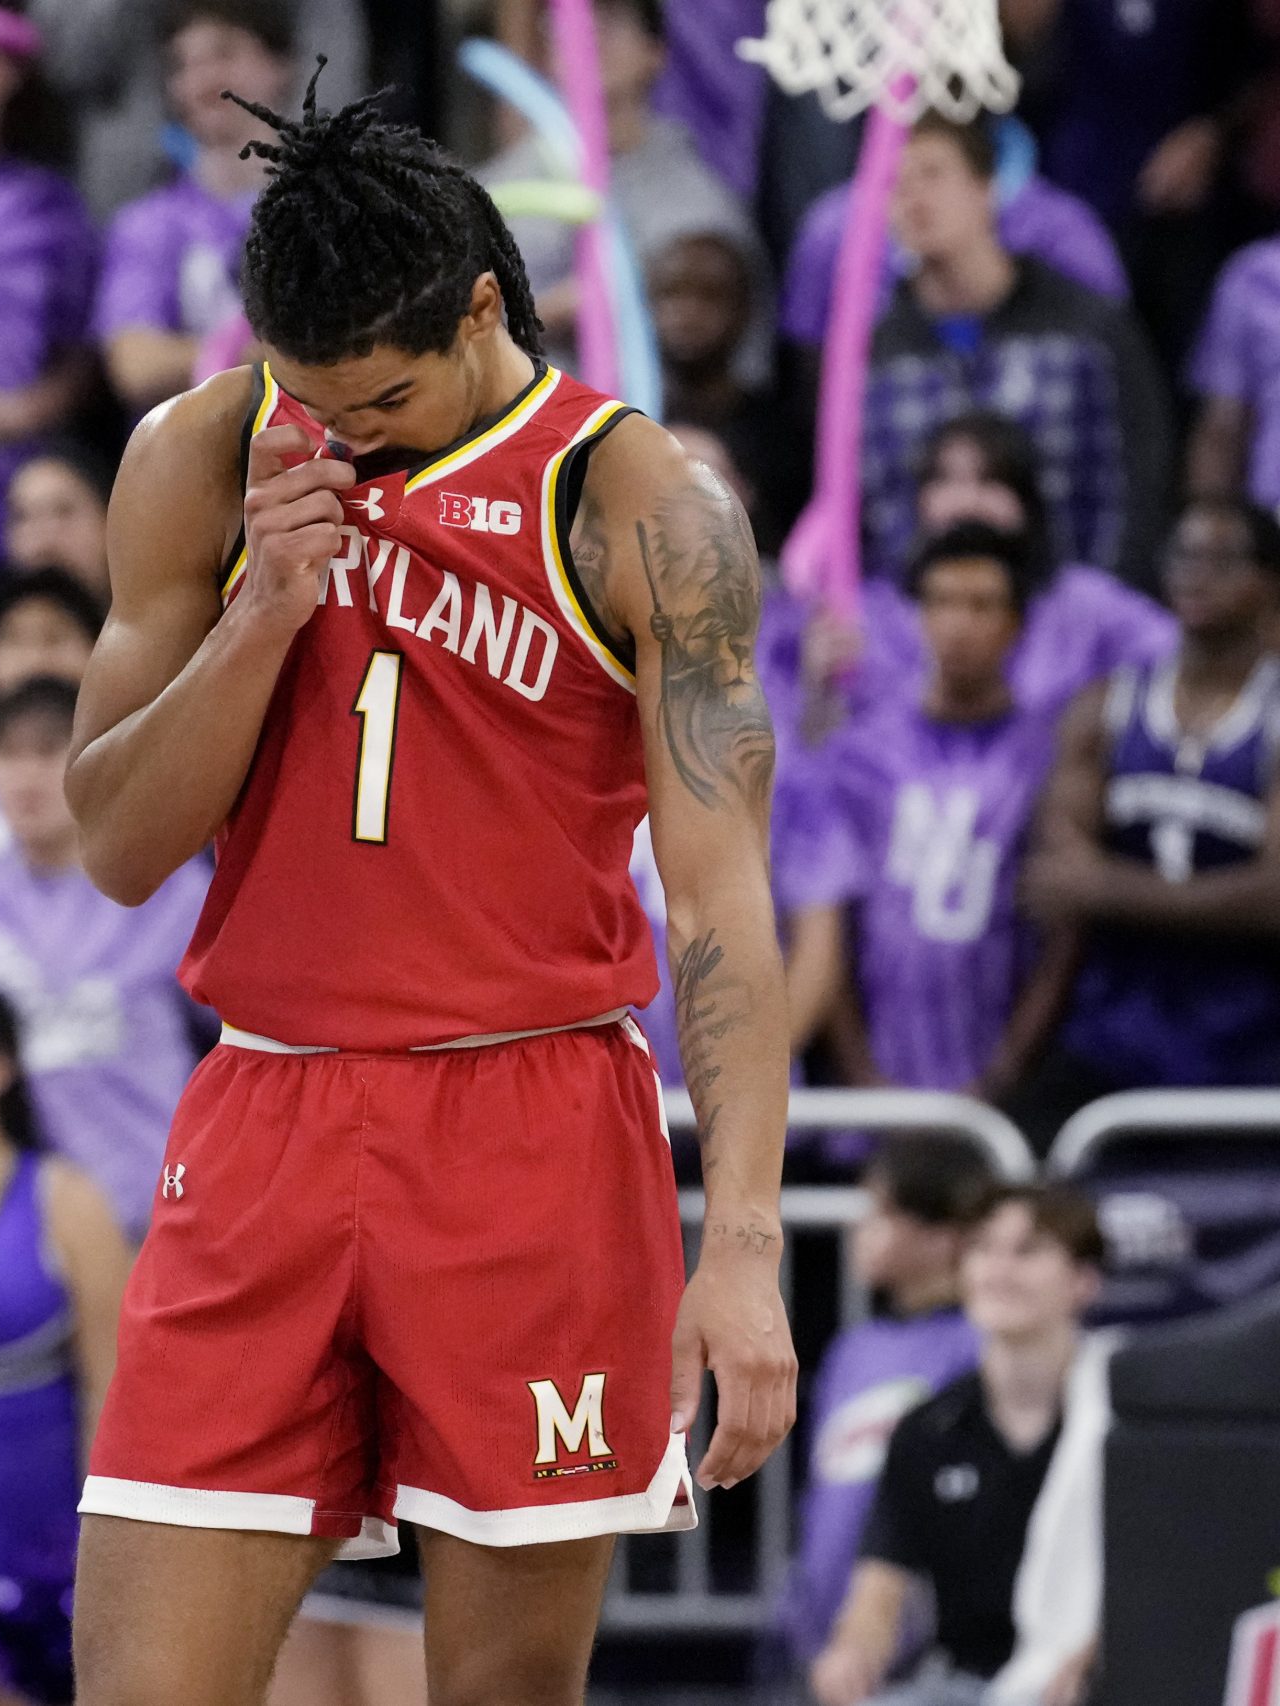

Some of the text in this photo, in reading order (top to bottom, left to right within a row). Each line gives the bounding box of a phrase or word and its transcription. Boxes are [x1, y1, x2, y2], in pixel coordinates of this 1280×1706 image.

[317, 525, 559, 702] RYLAND
[351, 647, 405, 845] 1
[525, 1371, 615, 1466] M
